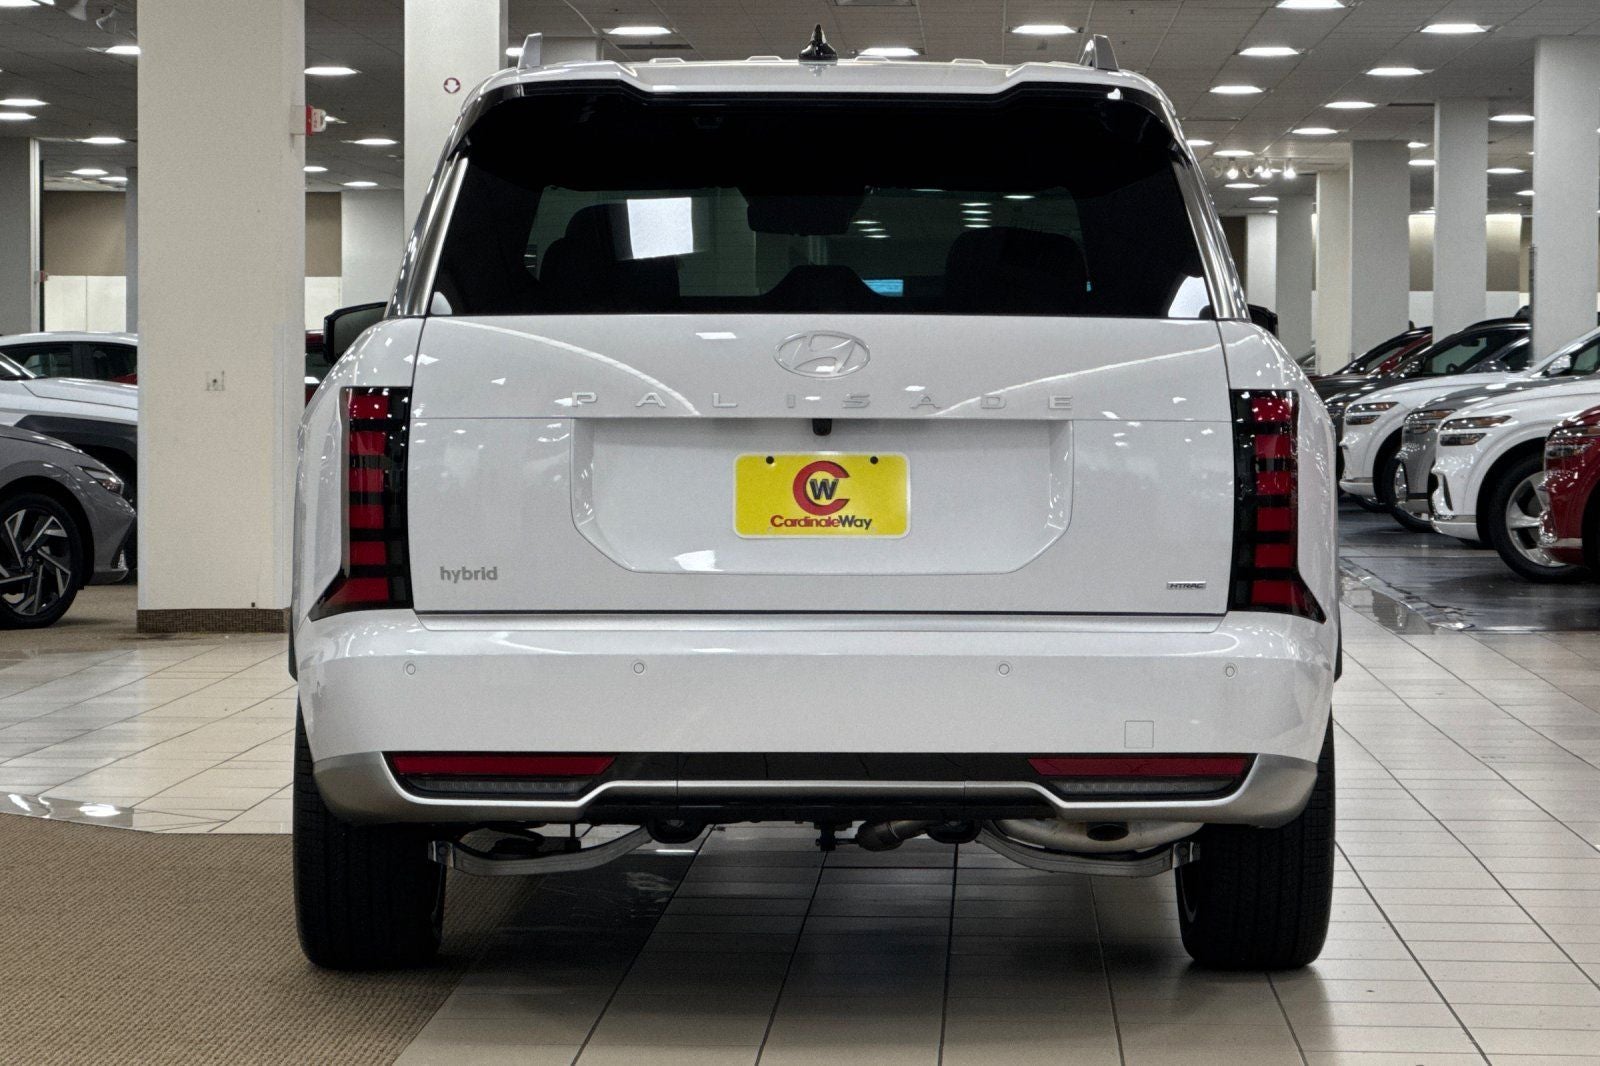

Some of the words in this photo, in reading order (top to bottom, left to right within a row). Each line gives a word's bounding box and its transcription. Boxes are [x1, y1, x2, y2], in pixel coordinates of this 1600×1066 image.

[571, 391, 1074, 410] PALISADE
[770, 514, 873, 530] CardinaleWay
[440, 565, 498, 584] hybrid
